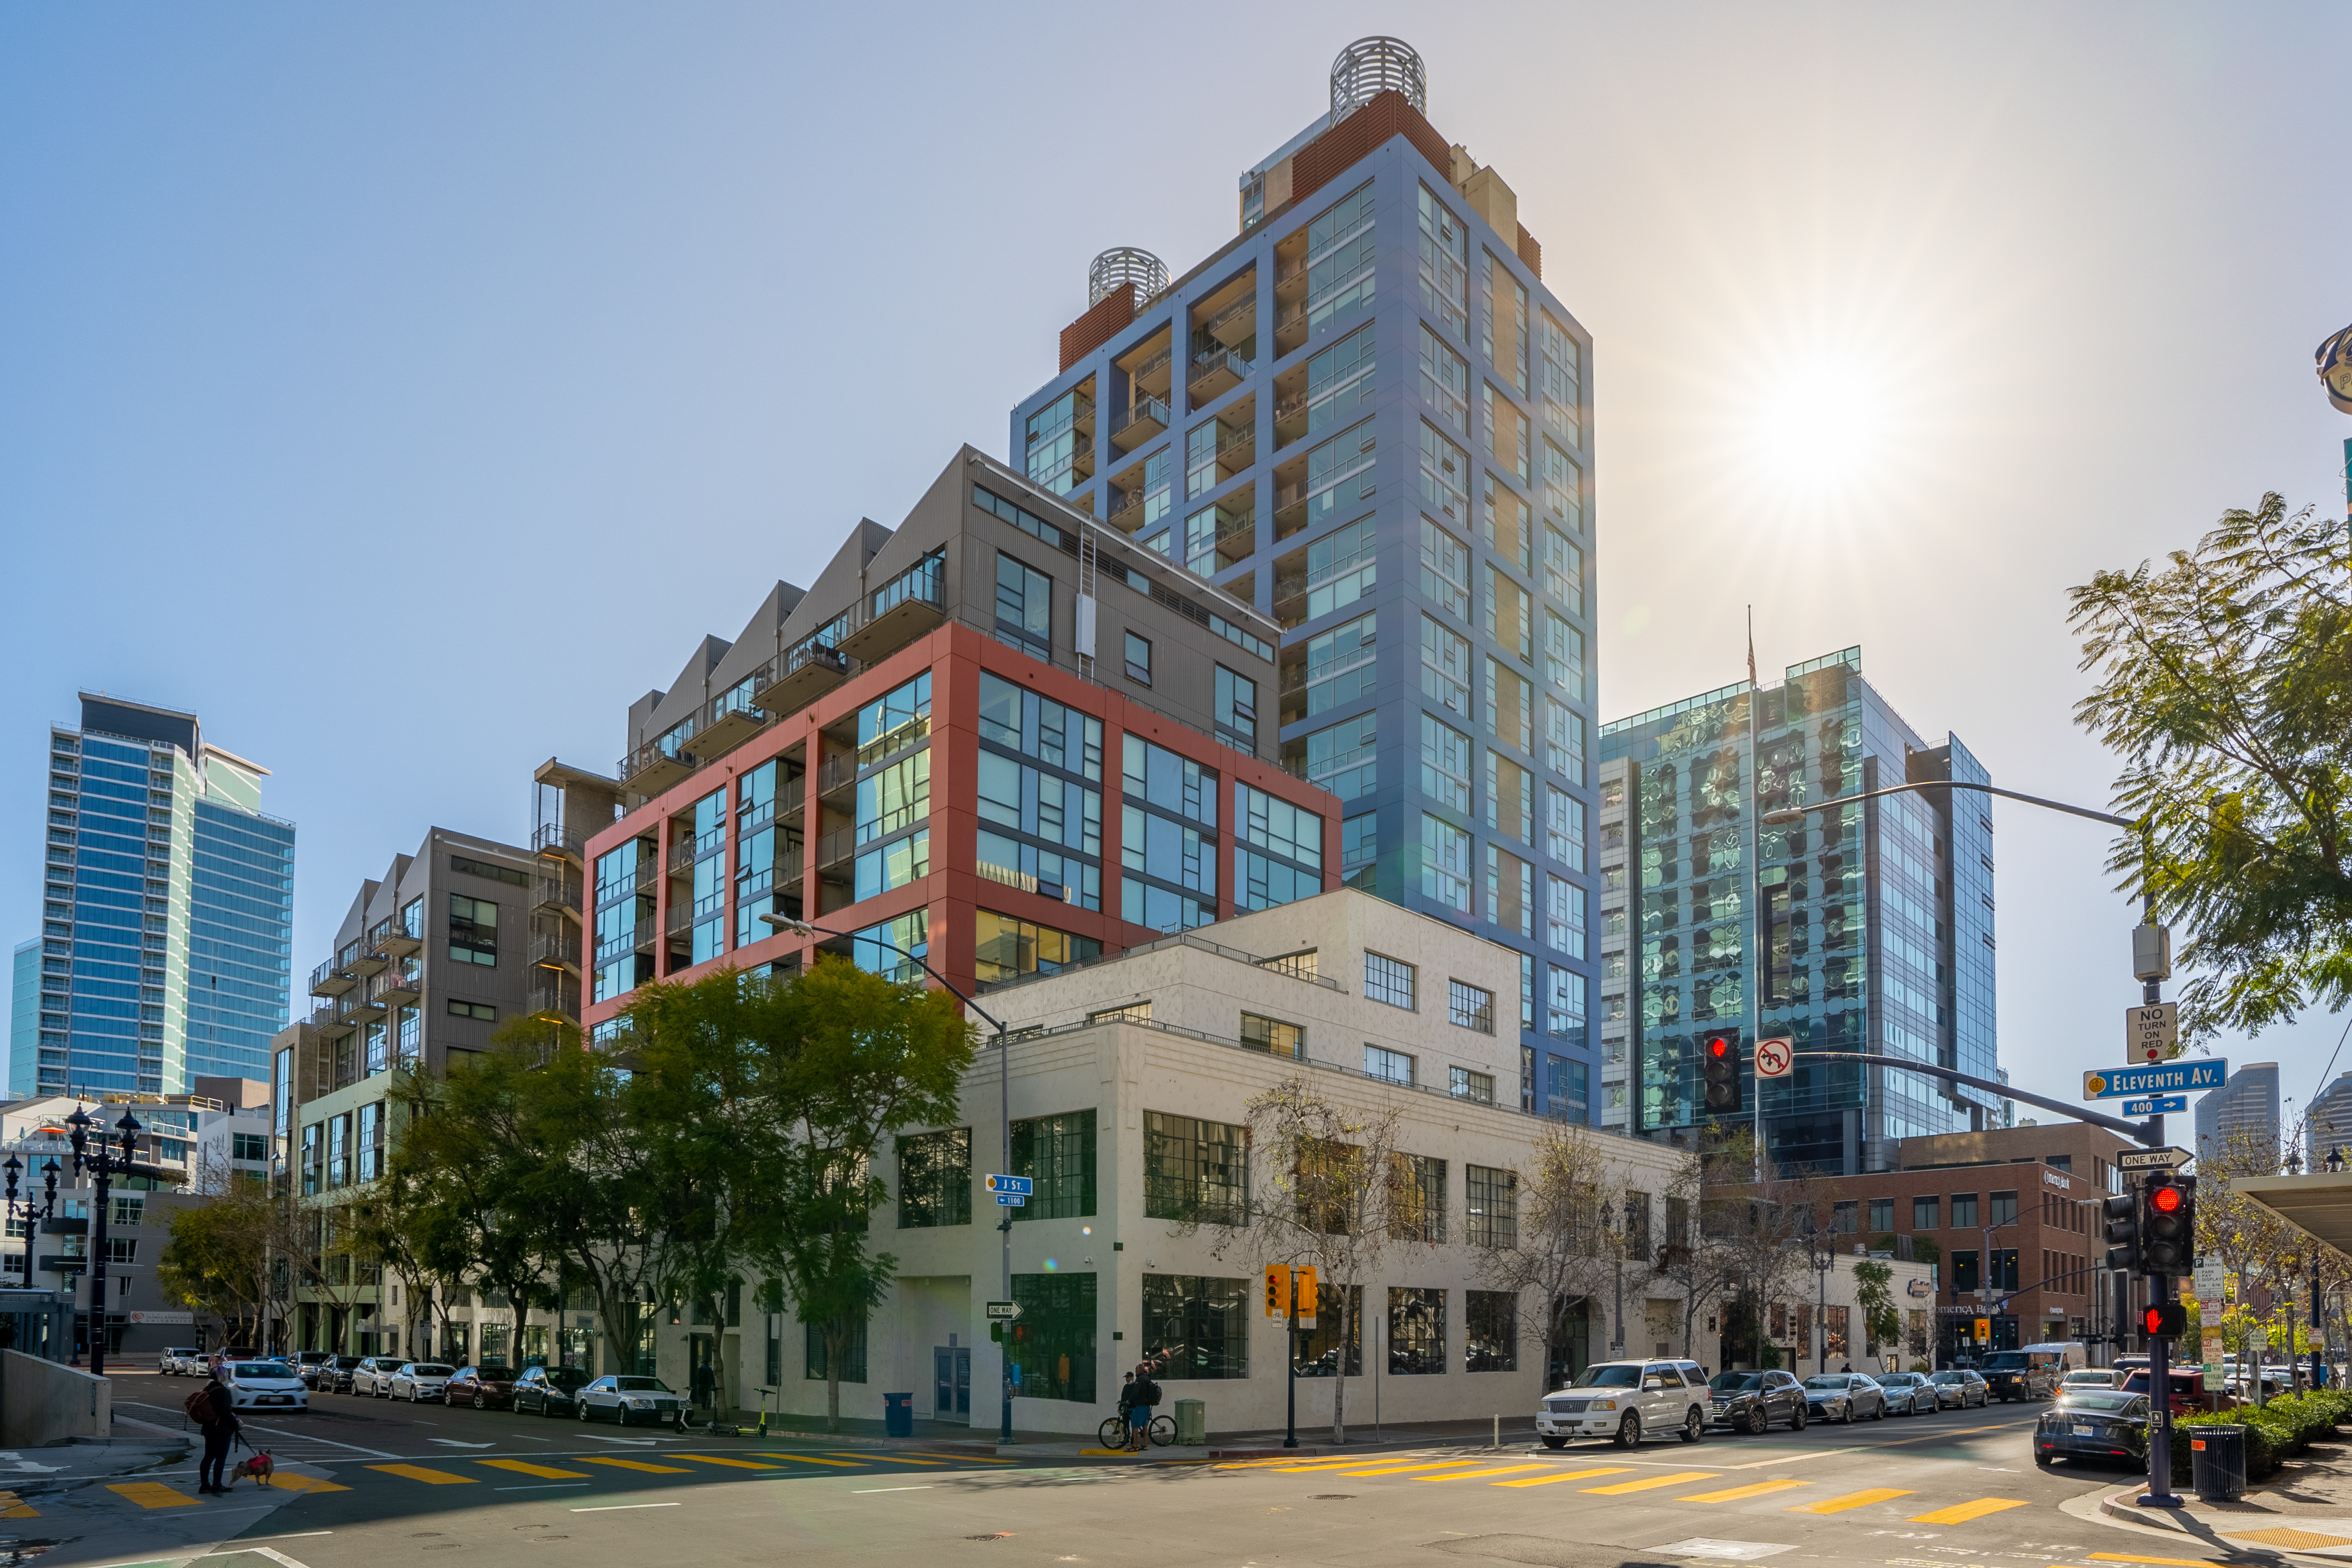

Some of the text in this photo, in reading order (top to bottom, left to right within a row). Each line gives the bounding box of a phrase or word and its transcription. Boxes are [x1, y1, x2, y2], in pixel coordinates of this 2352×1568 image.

[2141, 1009, 2163, 1021] NO
[2138, 1020, 2166, 1031] TURN
[2145, 1031, 2159, 1039] ON
[2142, 1040, 2163, 1049] RED
[2113, 1072, 2183, 1091] ELEVENTH
[2131, 1102, 2153, 1113] 400
[2125, 1153, 2171, 1165] ONE WAY
[1003, 1179, 1007, 1189] J
